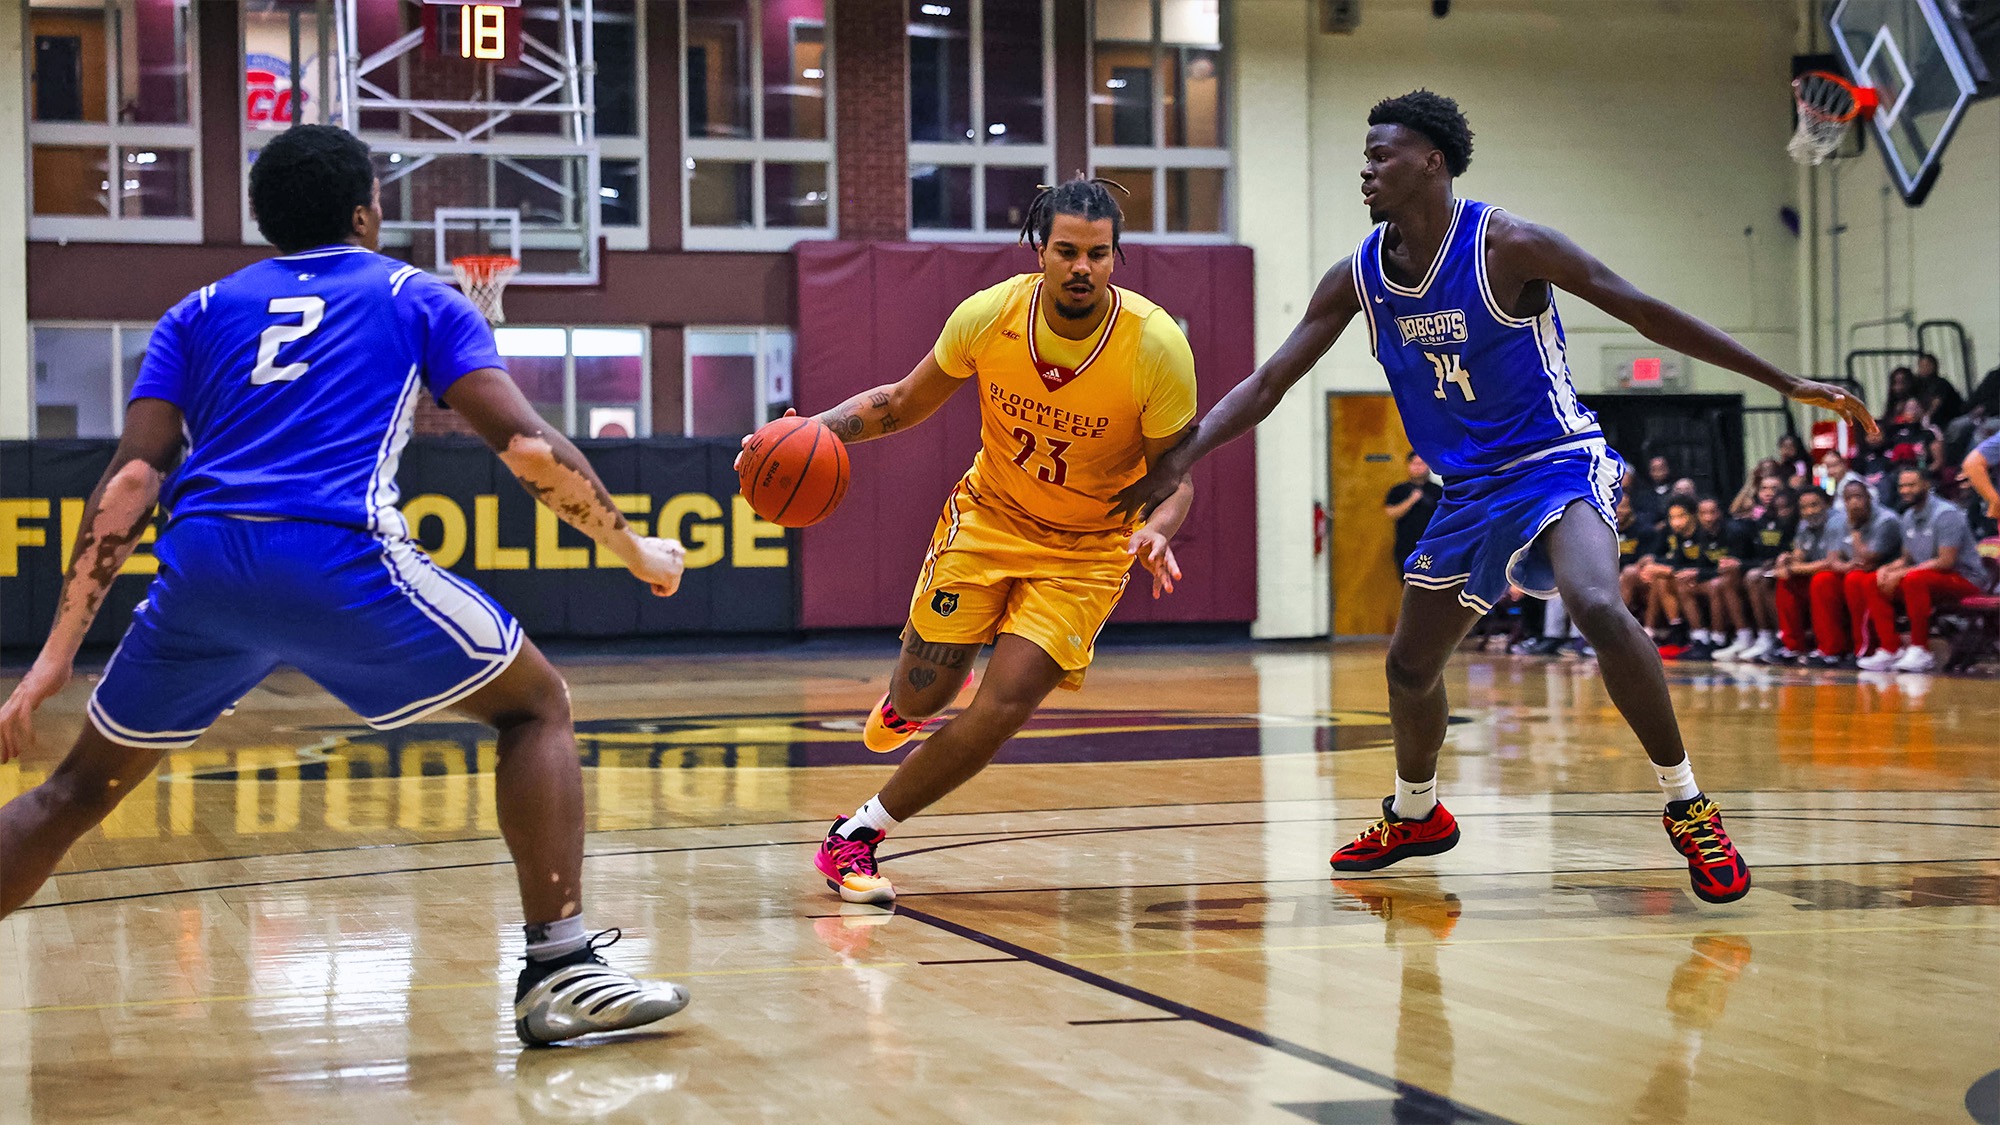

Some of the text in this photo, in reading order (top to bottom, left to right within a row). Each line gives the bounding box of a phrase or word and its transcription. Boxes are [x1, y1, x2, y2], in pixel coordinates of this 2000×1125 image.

[461, 4, 505, 60] 18
[250, 295, 326, 385] 2
[1400, 312, 1467, 340] BOBCATS
[990, 382, 1109, 428] BLOOMFIELD
[991, 394, 1106, 439] COLLEGE
[1012, 426, 1073, 487] 23
[400, 493, 789, 571] OLLEGE
